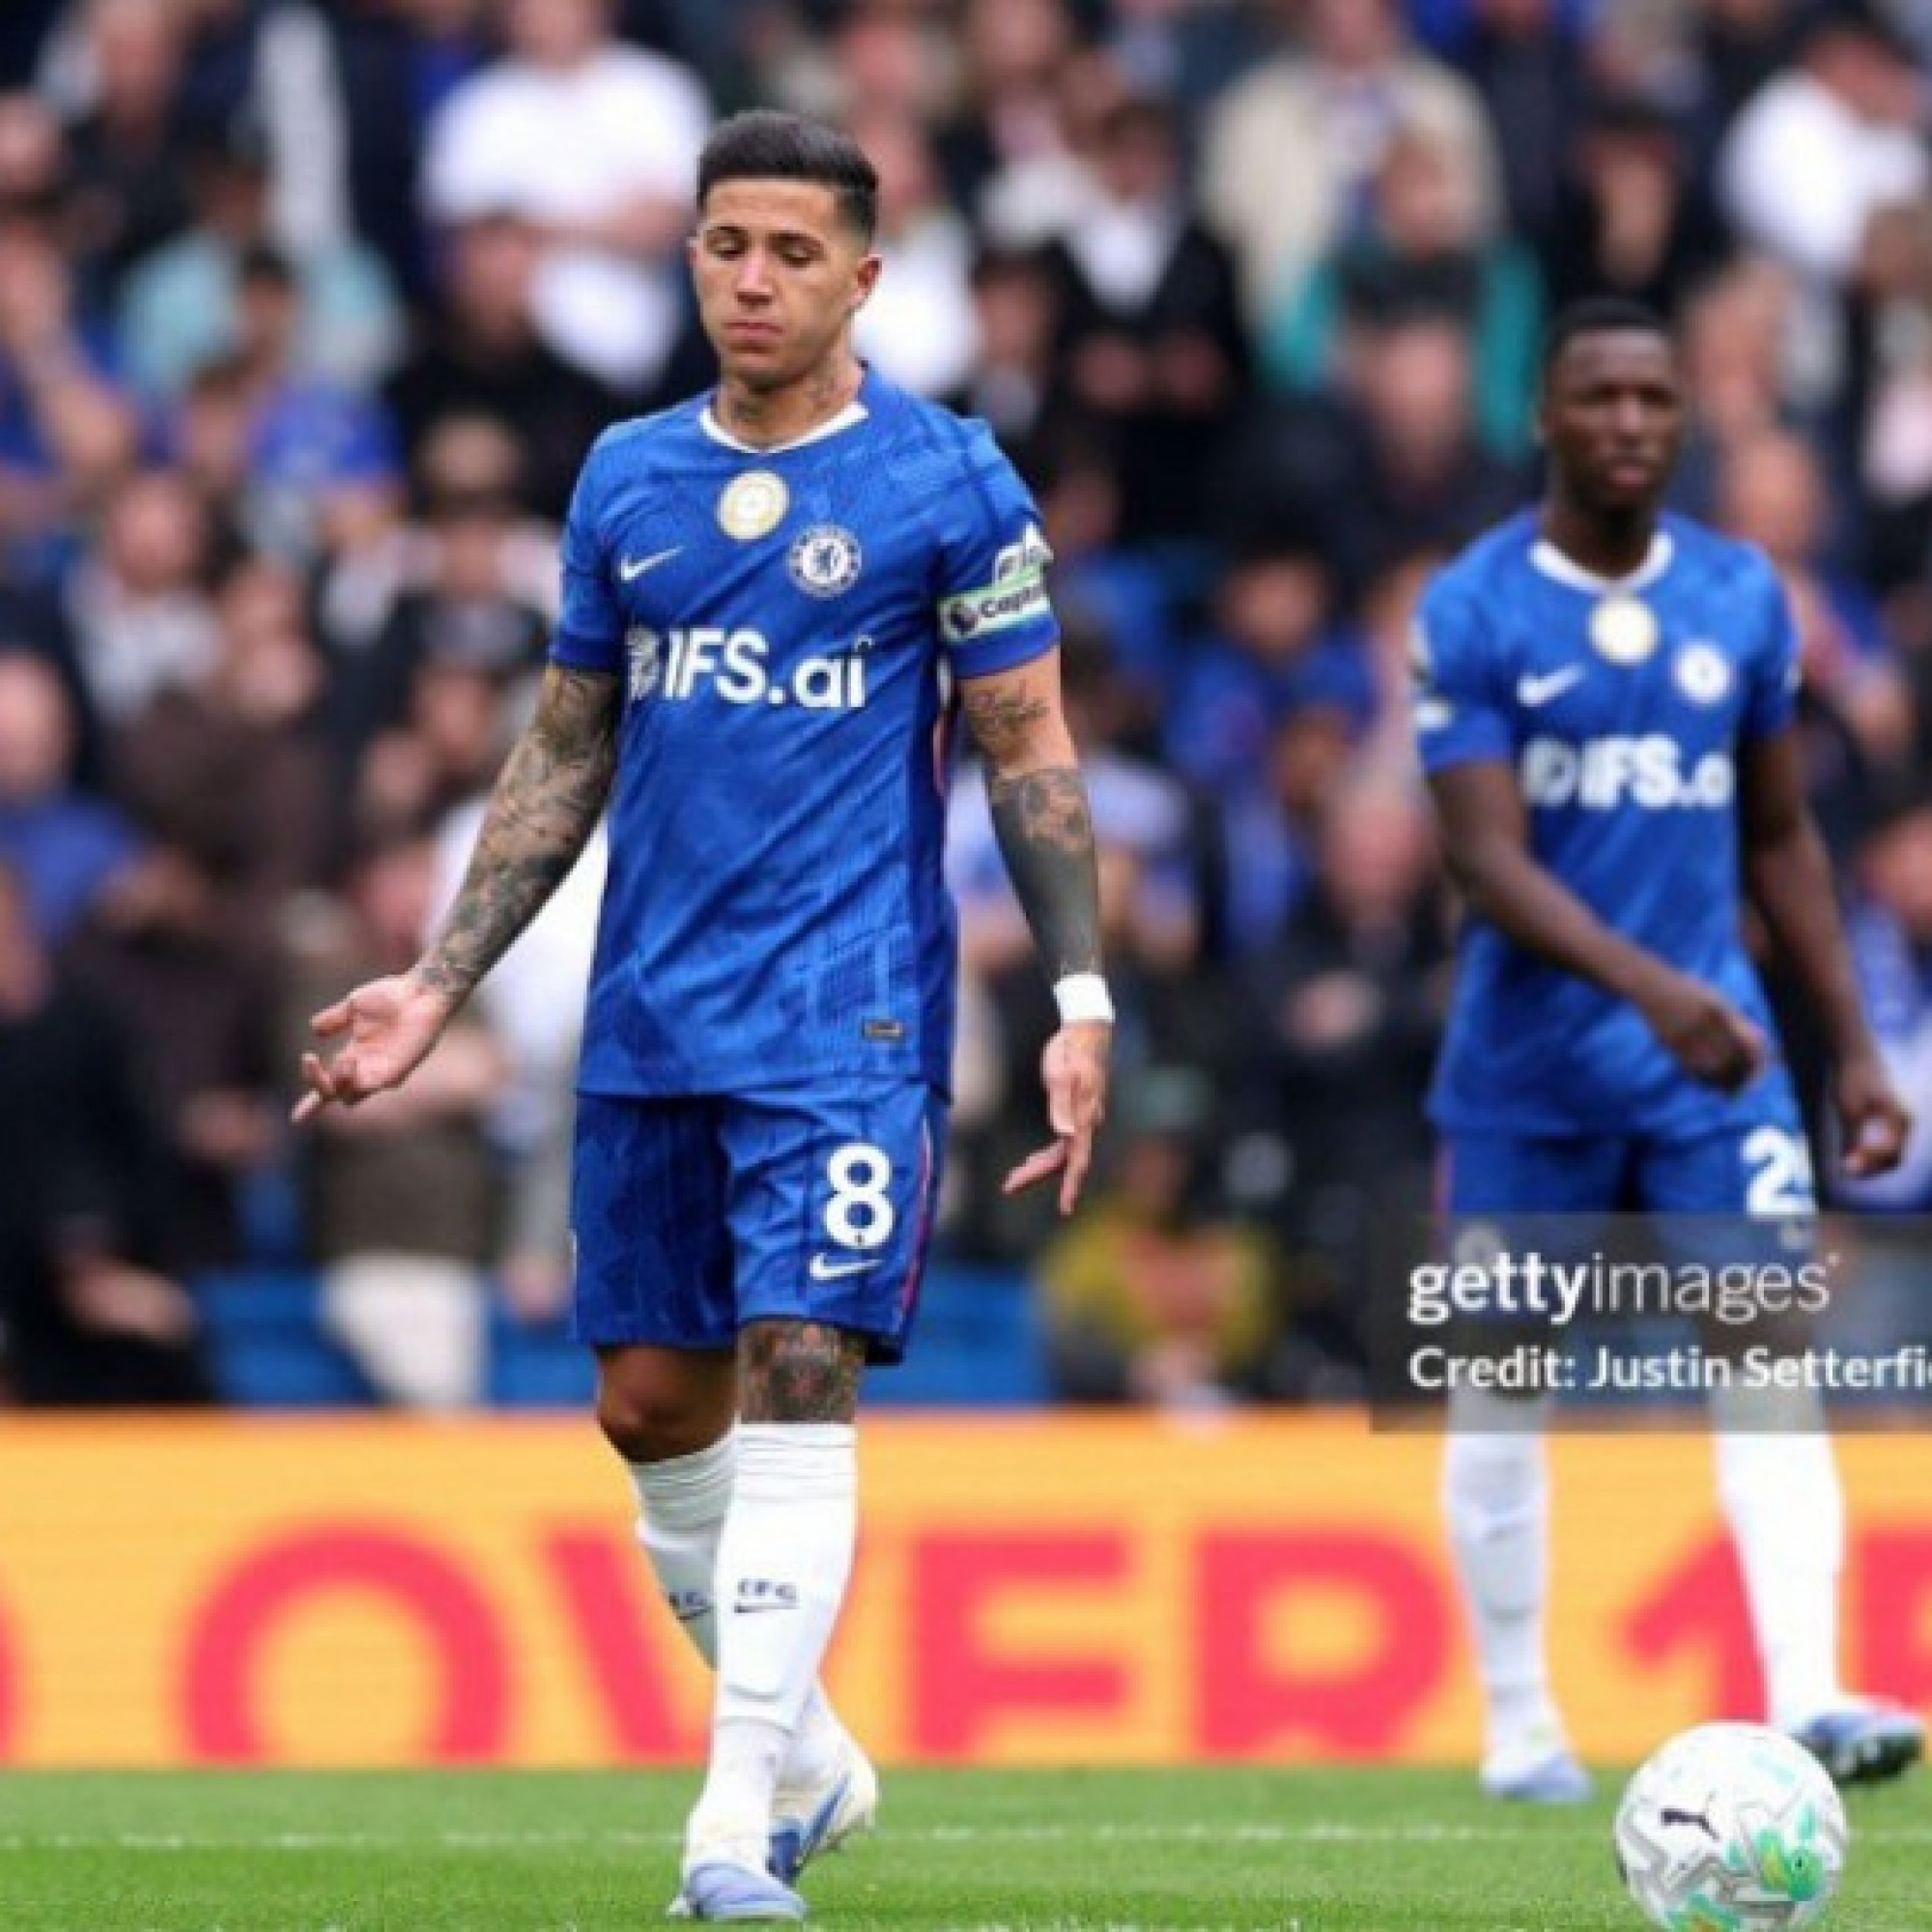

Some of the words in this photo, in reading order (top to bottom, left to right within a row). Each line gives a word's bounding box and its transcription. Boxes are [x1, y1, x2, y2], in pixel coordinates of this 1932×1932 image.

[663, 627, 874, 709] IFS.ai
[825, 1142, 895, 1247] 8
[1741, 1125, 1817, 1219] 2
